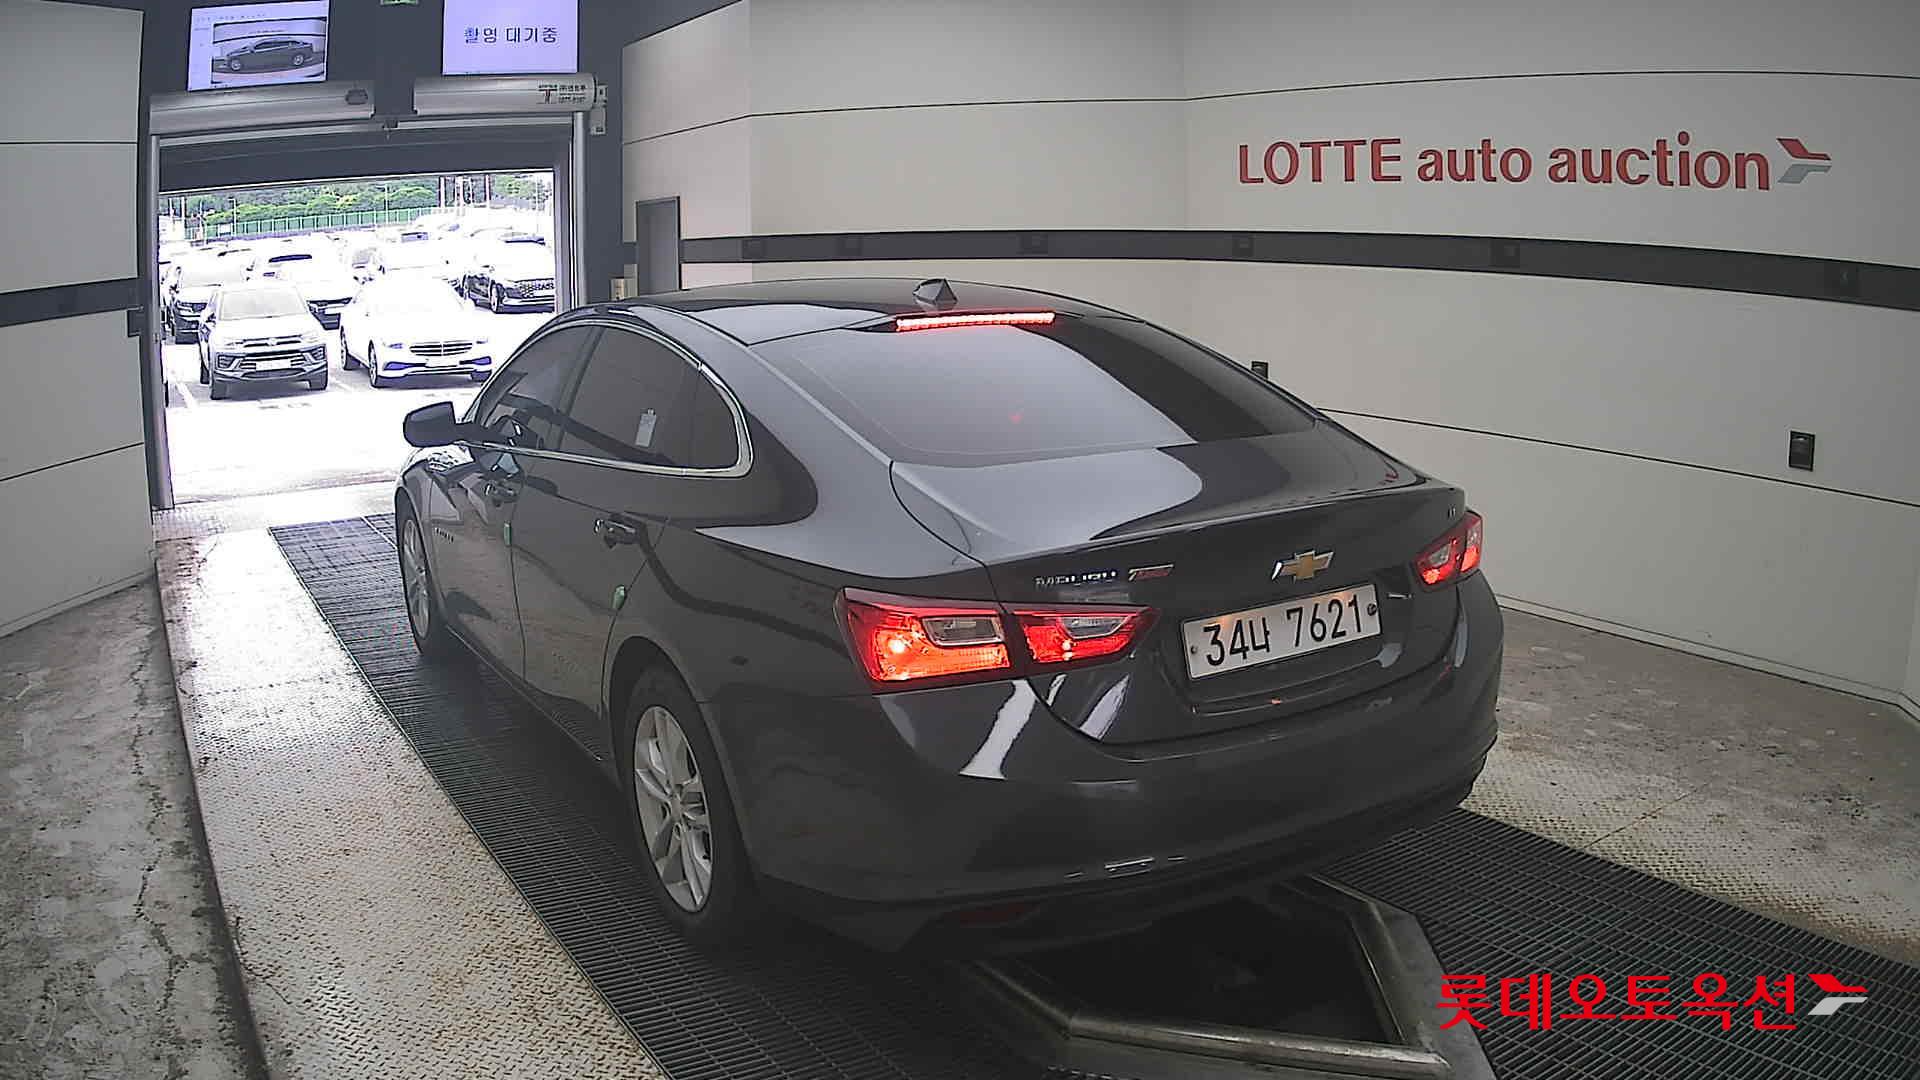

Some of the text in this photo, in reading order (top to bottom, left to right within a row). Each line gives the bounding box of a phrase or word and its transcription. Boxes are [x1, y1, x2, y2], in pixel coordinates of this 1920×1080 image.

[506, 26, 557, 43] 대기중
[1239, 131, 1770, 191] LOTTE auto auction
[1203, 594, 1362, 665] 34나 7621
